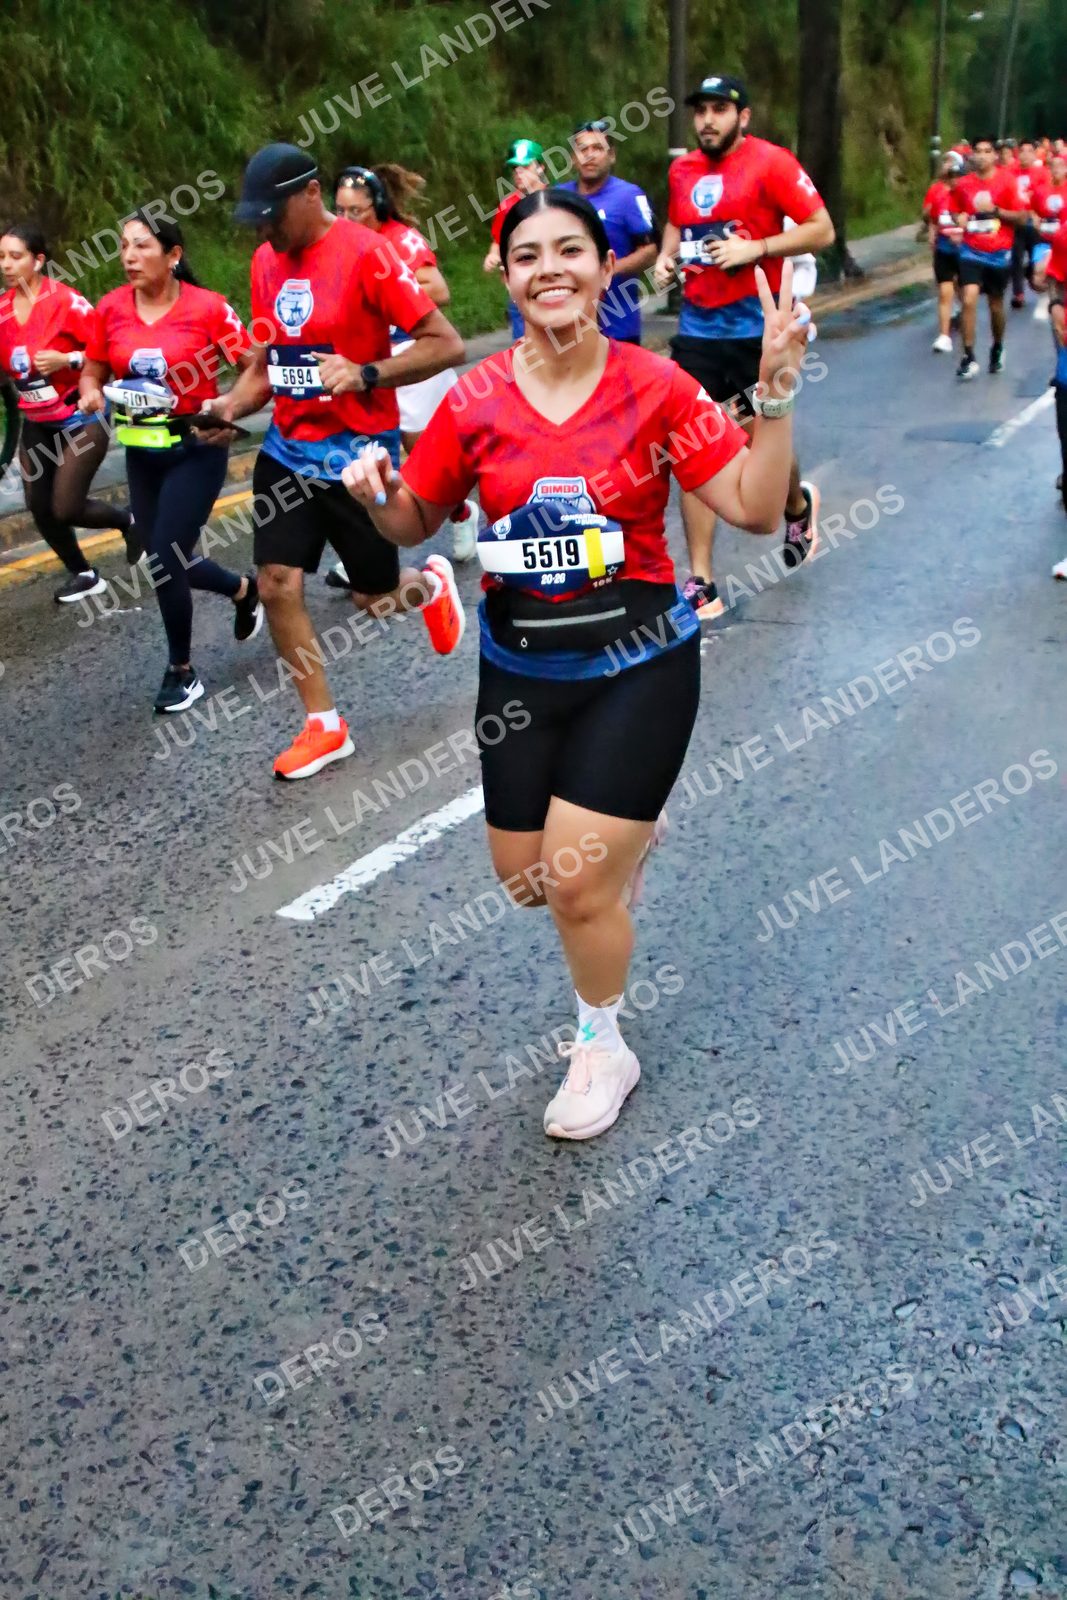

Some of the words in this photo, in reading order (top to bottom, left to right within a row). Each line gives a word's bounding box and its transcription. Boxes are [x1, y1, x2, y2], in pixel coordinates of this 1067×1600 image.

[282, 368, 313, 384] 5694
[541, 485, 579, 494] BIMBO
[522, 539, 580, 569] 5519
